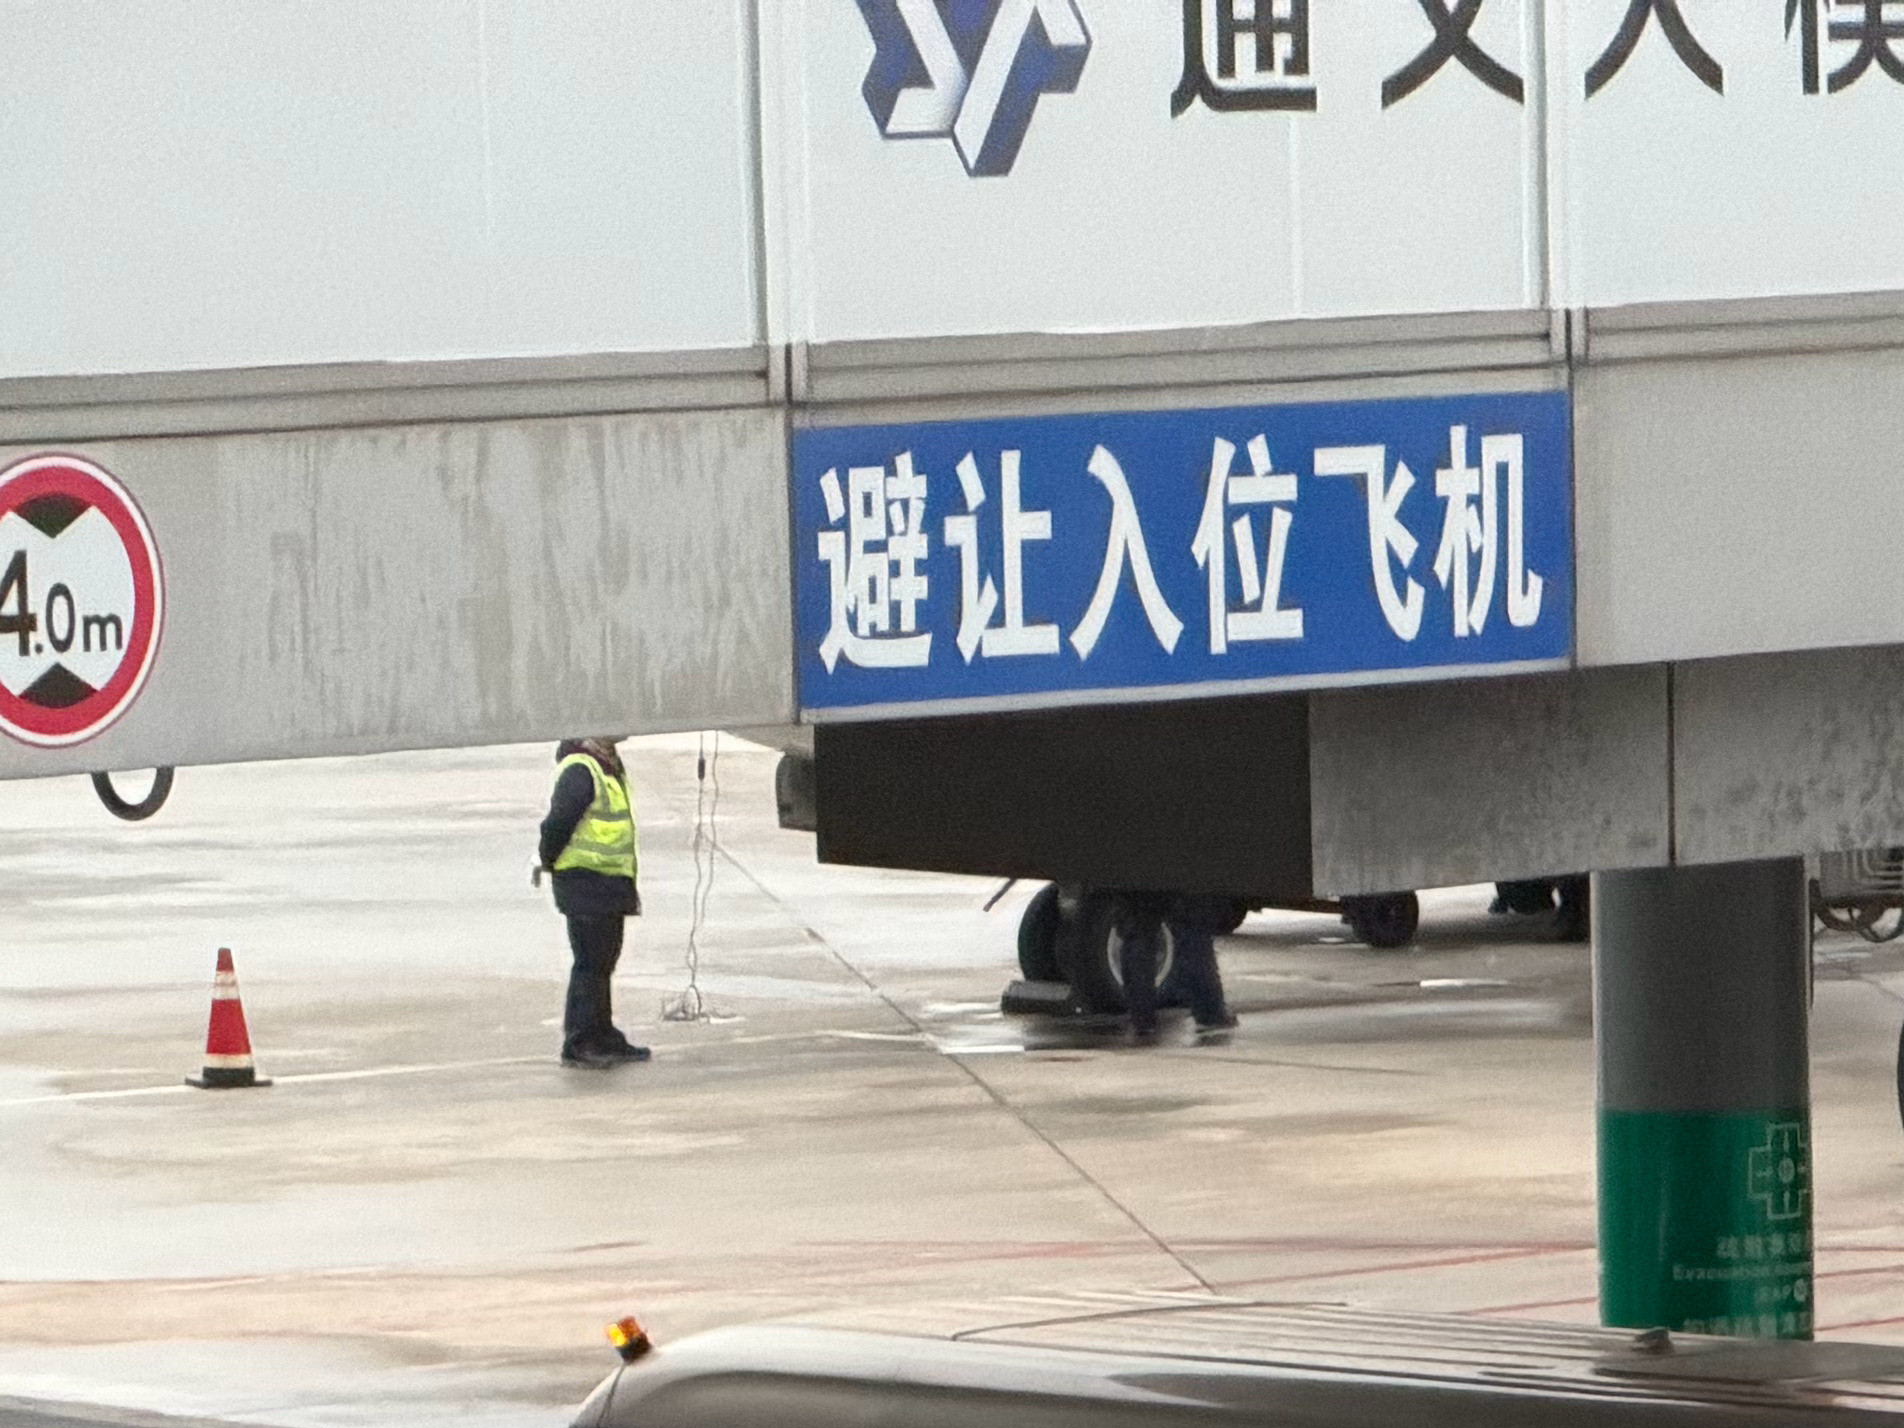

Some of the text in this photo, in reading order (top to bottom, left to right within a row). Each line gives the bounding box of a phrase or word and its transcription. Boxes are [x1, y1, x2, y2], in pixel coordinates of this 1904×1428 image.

[817, 424, 1544, 674] 避让入位飞机
